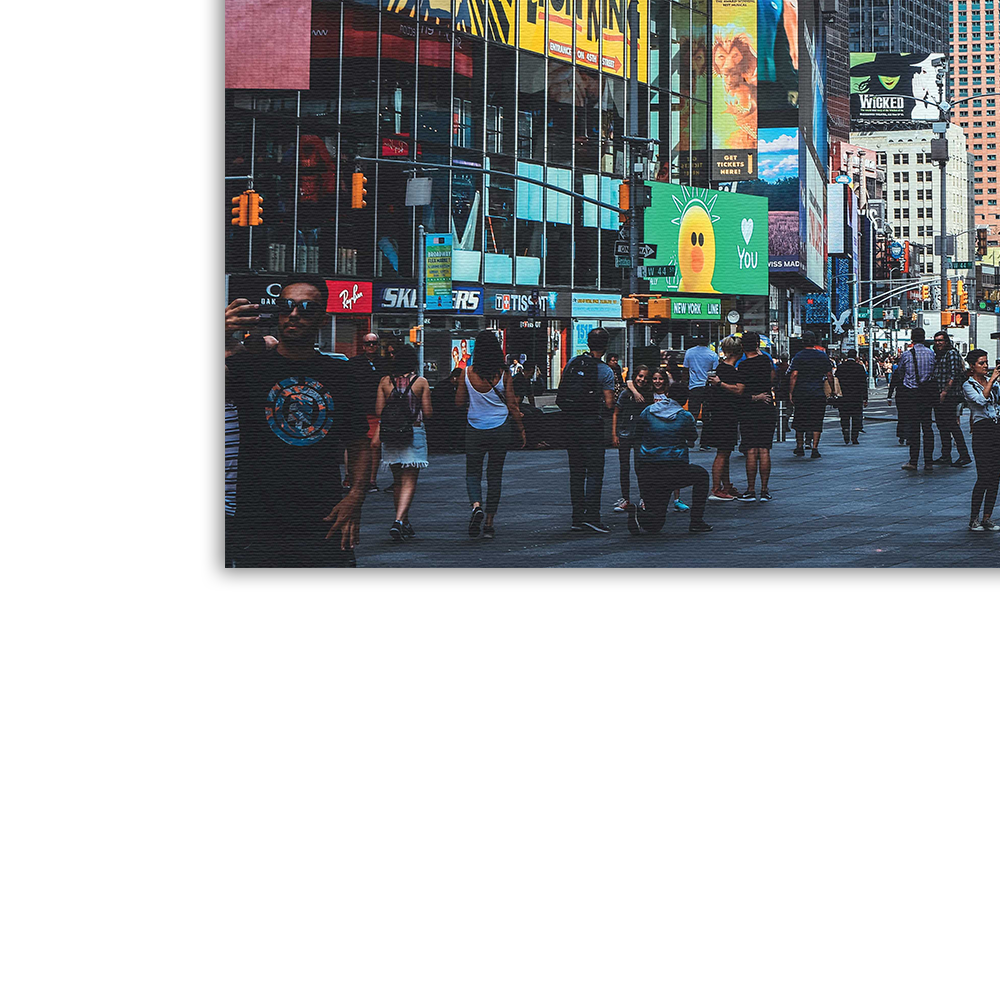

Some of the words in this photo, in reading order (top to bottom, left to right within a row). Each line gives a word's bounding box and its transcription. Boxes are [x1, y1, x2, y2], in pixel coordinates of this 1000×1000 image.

[549, 41, 572, 57] ENTRANCE
[576, 50, 585, 60] ON
[859, 93, 904, 109] WICKED
[648, 267, 654, 276] W
[658, 267, 666, 275] 44
[673, 303, 686, 315] NEW
[687, 303, 702, 315] YORK
